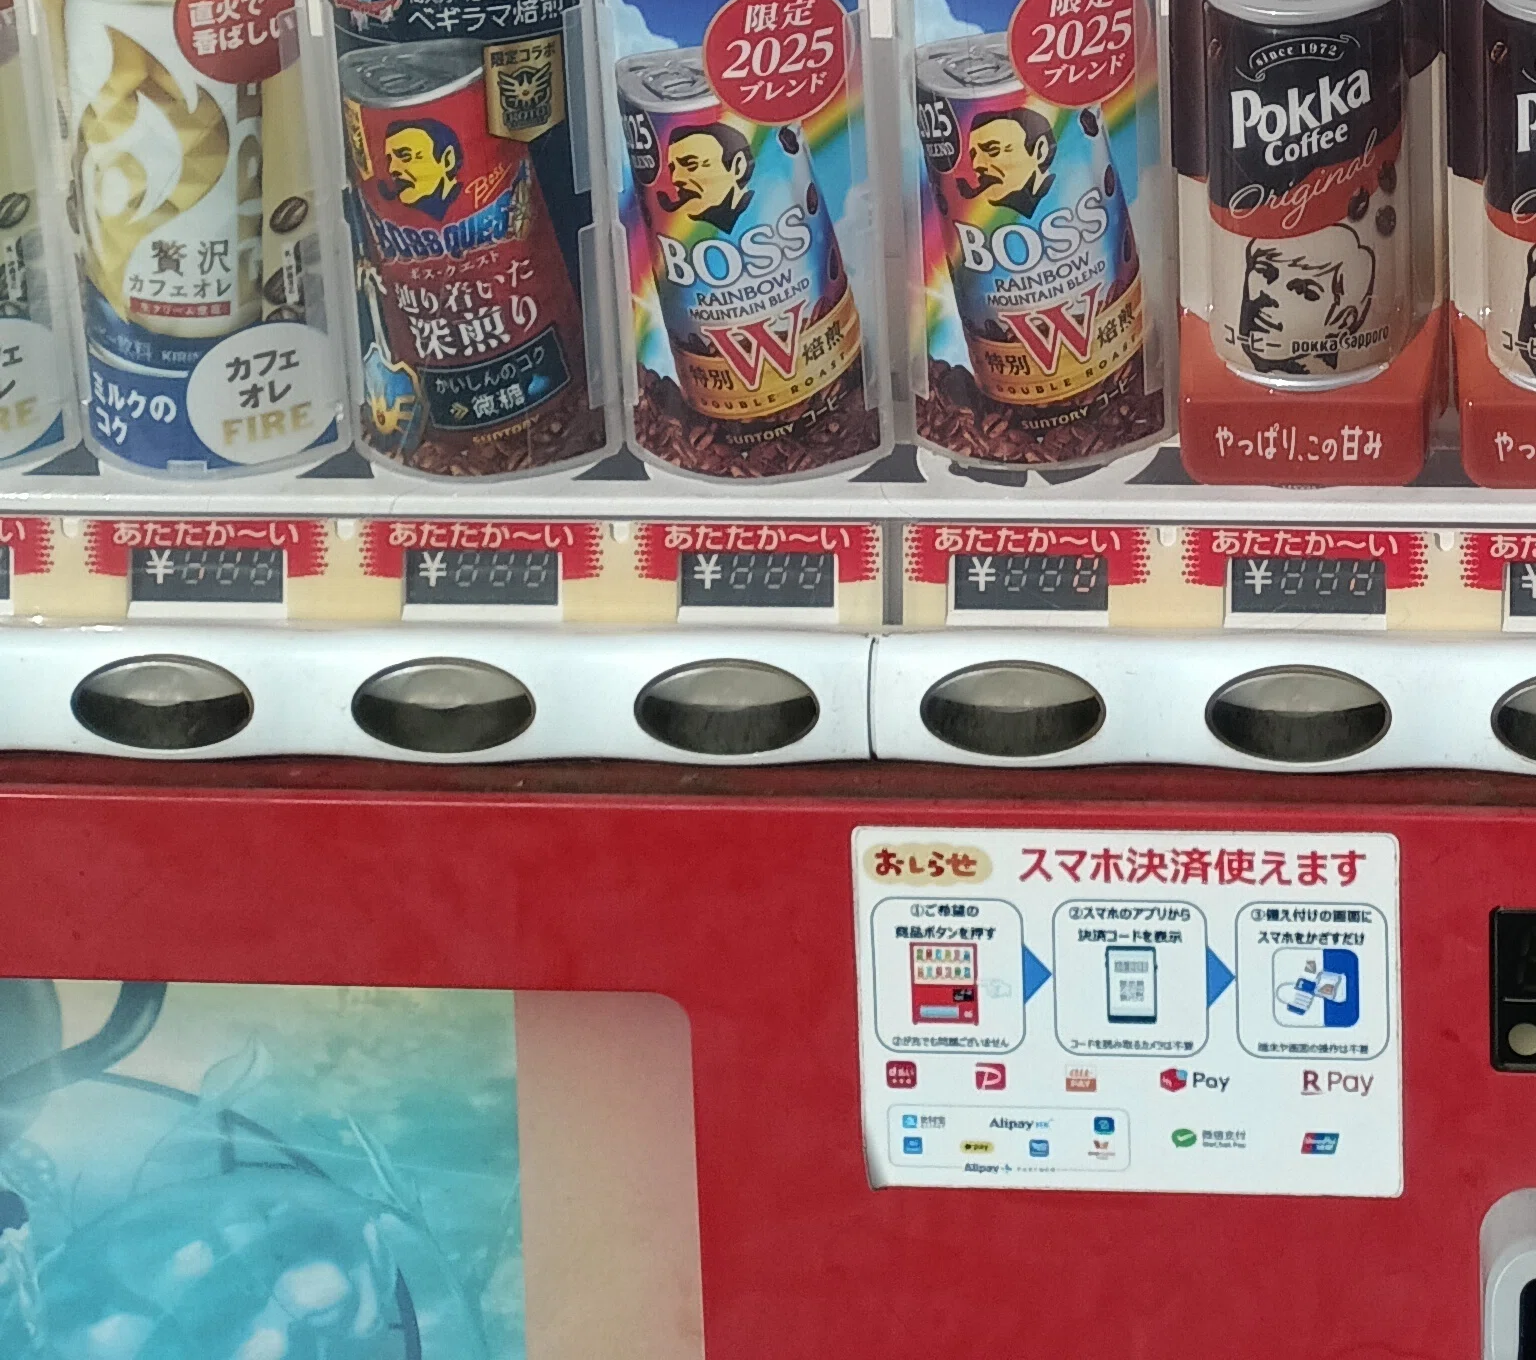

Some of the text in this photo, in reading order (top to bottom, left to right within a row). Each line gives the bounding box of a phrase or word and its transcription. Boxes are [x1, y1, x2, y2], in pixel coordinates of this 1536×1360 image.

[1027, 9, 1132, 62] 2025
[722, 27, 836, 80] 2025
[1255, 45, 1295, 66] since
[739, 72, 827, 104] ブレンド
[1265, 121, 1348, 166] Coffee
[1229, 130, 1379, 229] Original
[657, 207, 813, 288] BOSS
[955, 189, 1109, 275] BOSS
[152, 241, 230, 276] 贅沢
[696, 269, 792, 308] RAINBOW
[987, 288, 1063, 308] MOUNTAIN
[689, 300, 767, 321] MOUNTAIN
[226, 350, 299, 382] カフェ
[238, 380, 291, 412] オレ
[222, 401, 313, 446] FIRE
[726, 424, 793, 445] SUNTORY
[1022, 408, 1088, 430] SUNTORY
[875, 850, 978, 877] おしらせ
[1019, 847, 1366, 886] スマホ決済使えます
[895, 925, 996, 940] 商品ボタンを押す
[1258, 930, 1364, 946] スマホをかざすだけ
[1192, 1071, 1230, 1092] Pay
[990, 1117, 1034, 1130] Alipay
